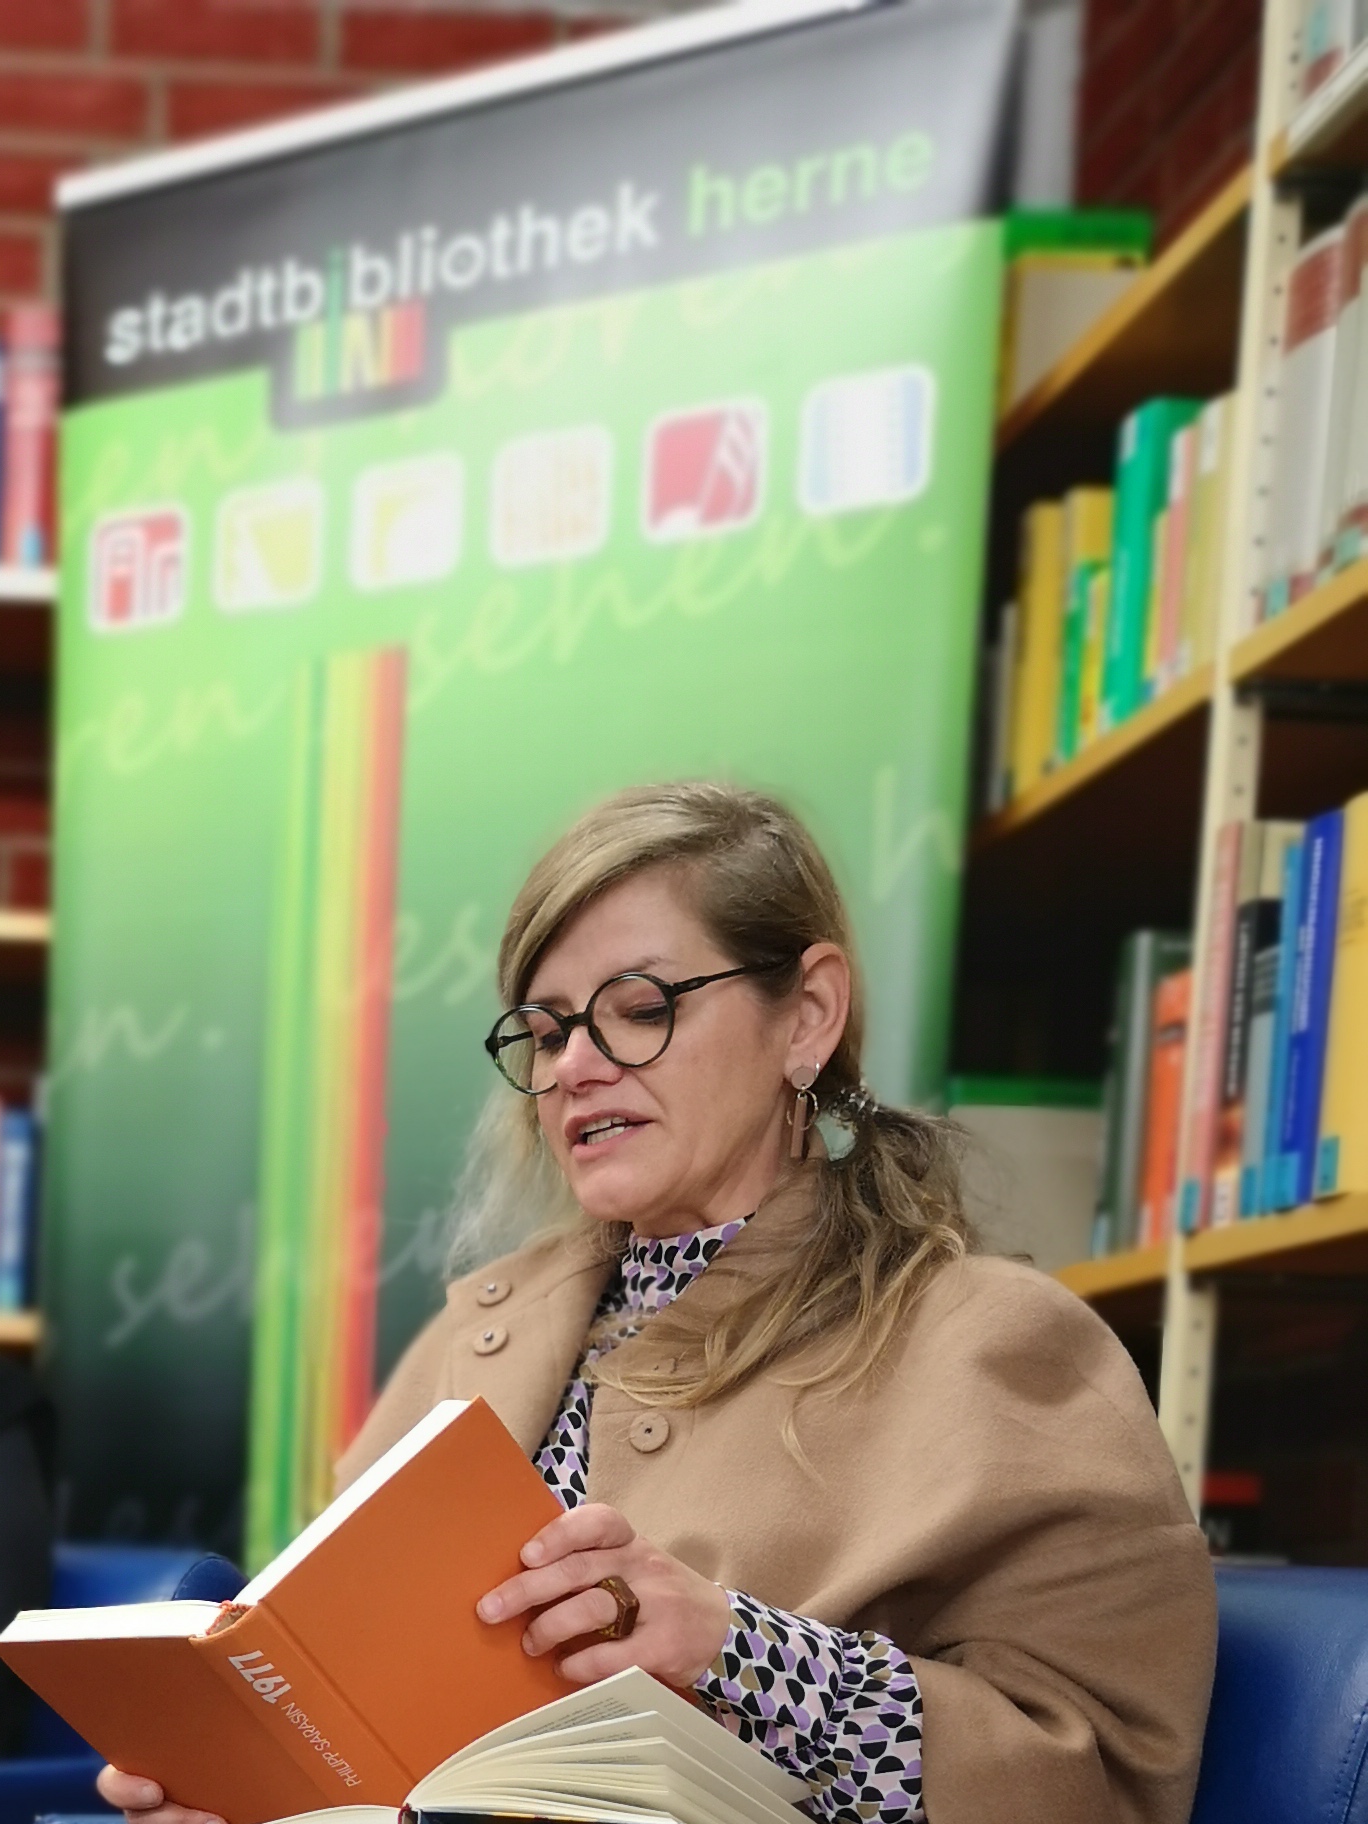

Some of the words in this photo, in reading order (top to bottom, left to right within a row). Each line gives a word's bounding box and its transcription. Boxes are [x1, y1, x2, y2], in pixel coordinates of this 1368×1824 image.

[104, 180, 659, 366] stadtbibliothek
[687, 129, 934, 239] herne
[227, 1649, 292, 1705] 1977
[281, 1701, 331, 1753] SARASIN
[322, 1752, 362, 1788] PHILIPP
